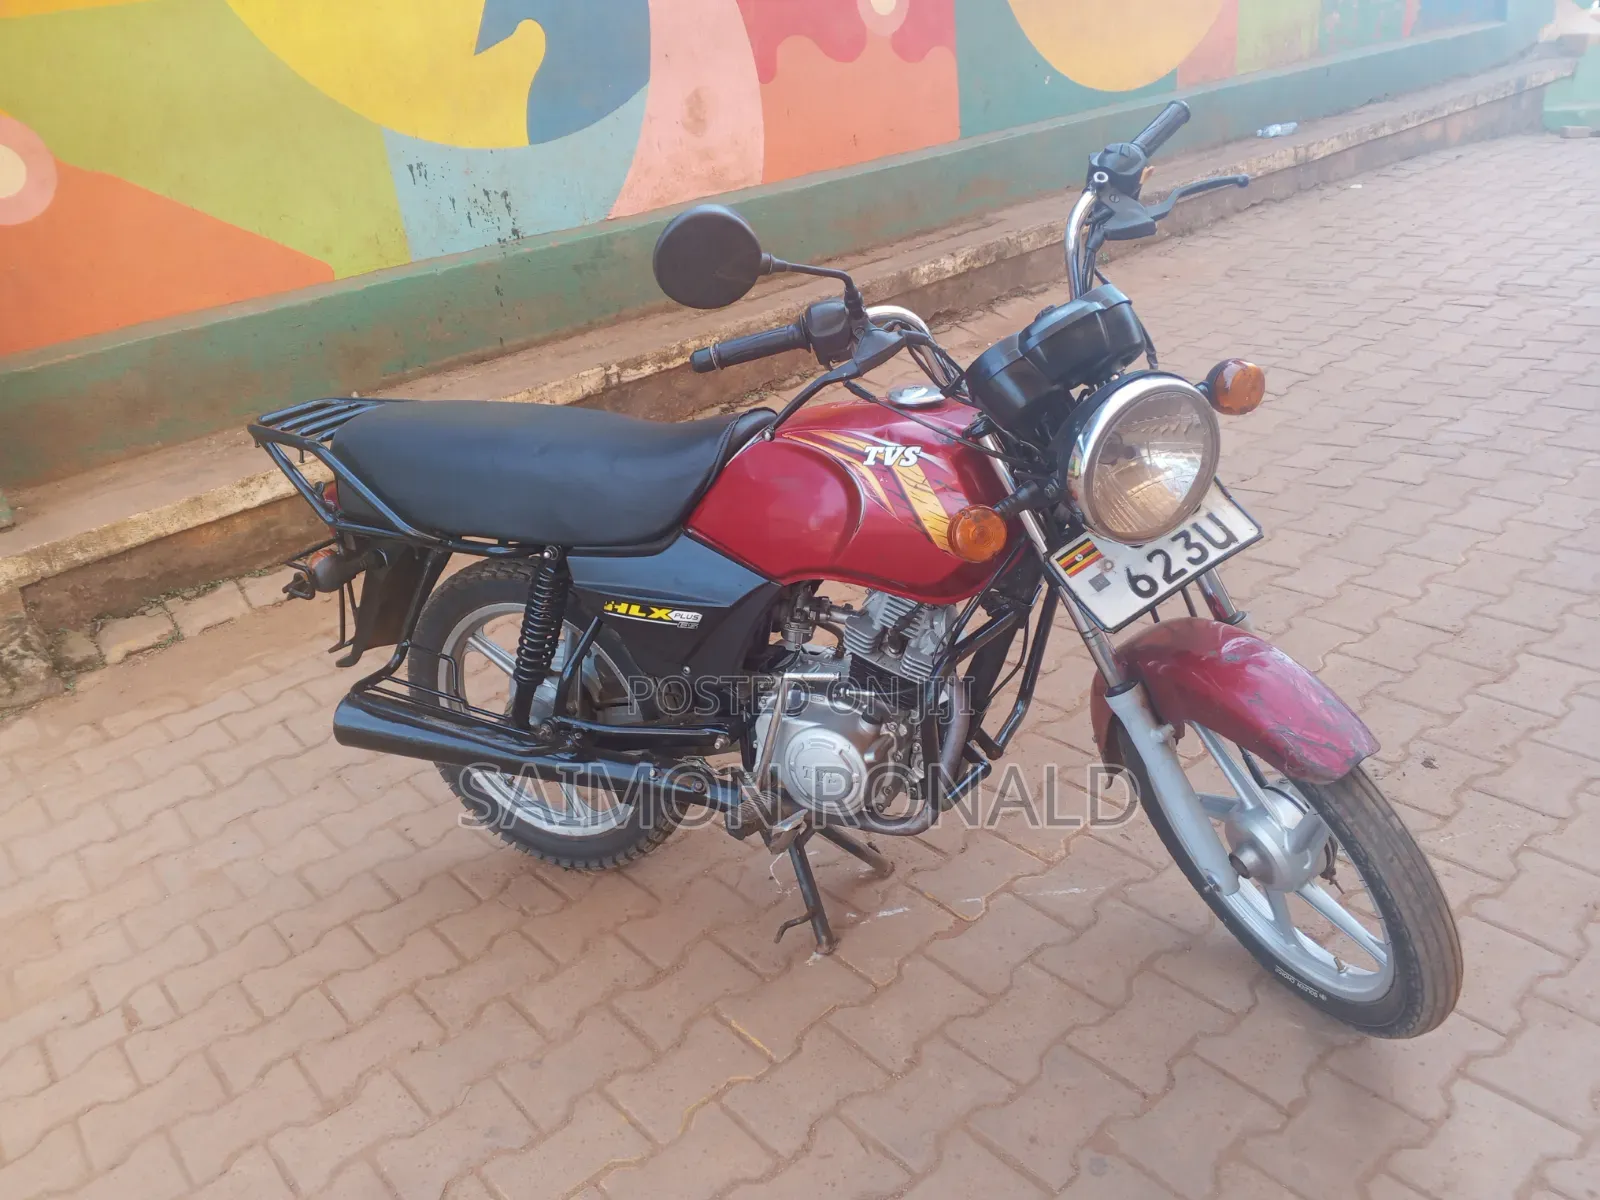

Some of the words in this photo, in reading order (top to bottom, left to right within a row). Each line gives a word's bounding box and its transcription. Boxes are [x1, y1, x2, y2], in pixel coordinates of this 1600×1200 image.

[863, 446, 921, 467] TVS
[1124, 512, 1239, 599] 623U
[604, 601, 672, 621] HLX
[674, 612, 700, 621] PLUS
